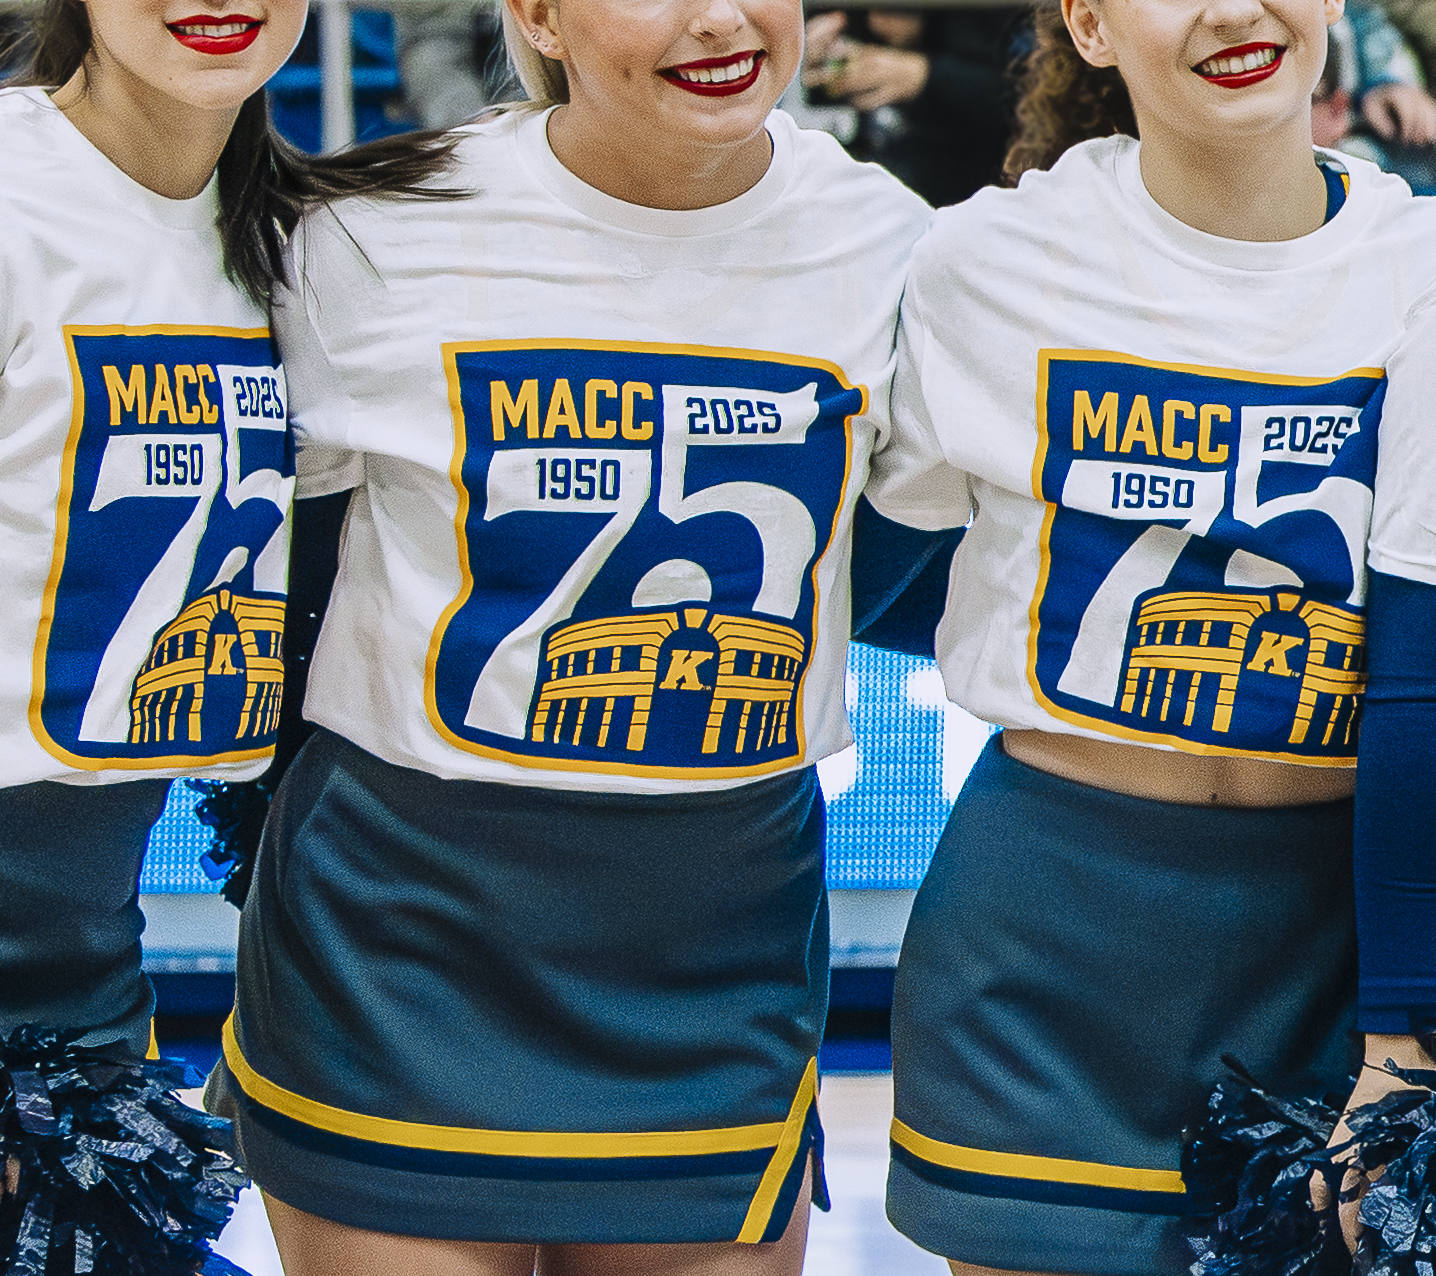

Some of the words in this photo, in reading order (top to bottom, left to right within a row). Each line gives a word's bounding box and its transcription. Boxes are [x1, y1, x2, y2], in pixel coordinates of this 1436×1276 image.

[102, 363, 219, 426] MACC
[232, 376, 285, 420] 2025
[489, 377, 655, 442] MACC
[685, 396, 782, 435] 2025
[1072, 390, 1231, 463] MACC
[1262, 415, 1352, 456] 2025
[143, 442, 204, 486] 1950
[536, 456, 621, 501] 1950
[1110, 471, 1195, 510] 1950
[464, 382, 819, 739] 75
[207, 633, 237, 676] K
[659, 649, 714, 691] K
[1246, 630, 1304, 677] K
